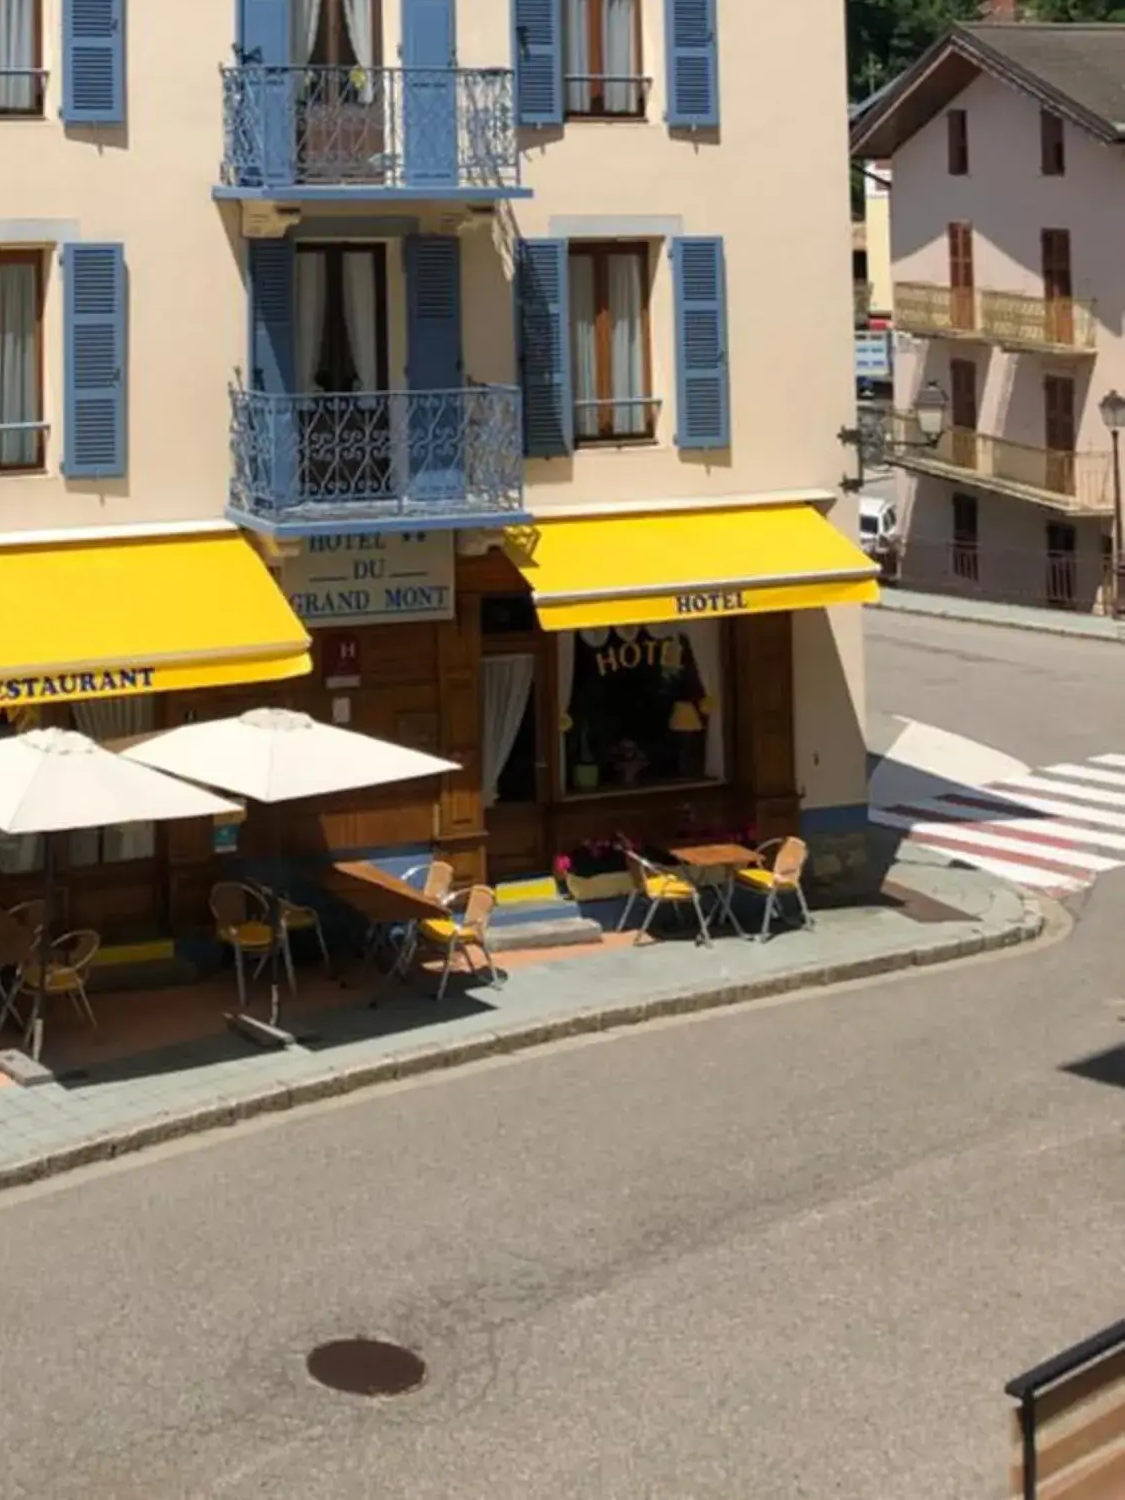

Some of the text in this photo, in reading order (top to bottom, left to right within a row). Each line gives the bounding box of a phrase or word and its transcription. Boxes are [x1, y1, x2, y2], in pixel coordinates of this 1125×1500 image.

[309, 532, 386, 551] HOTEL
[352, 558, 386, 580] DU
[290, 586, 449, 614] GRAND MONT
[676, 592, 747, 612] HOTEL
[339, 642, 357, 659] H
